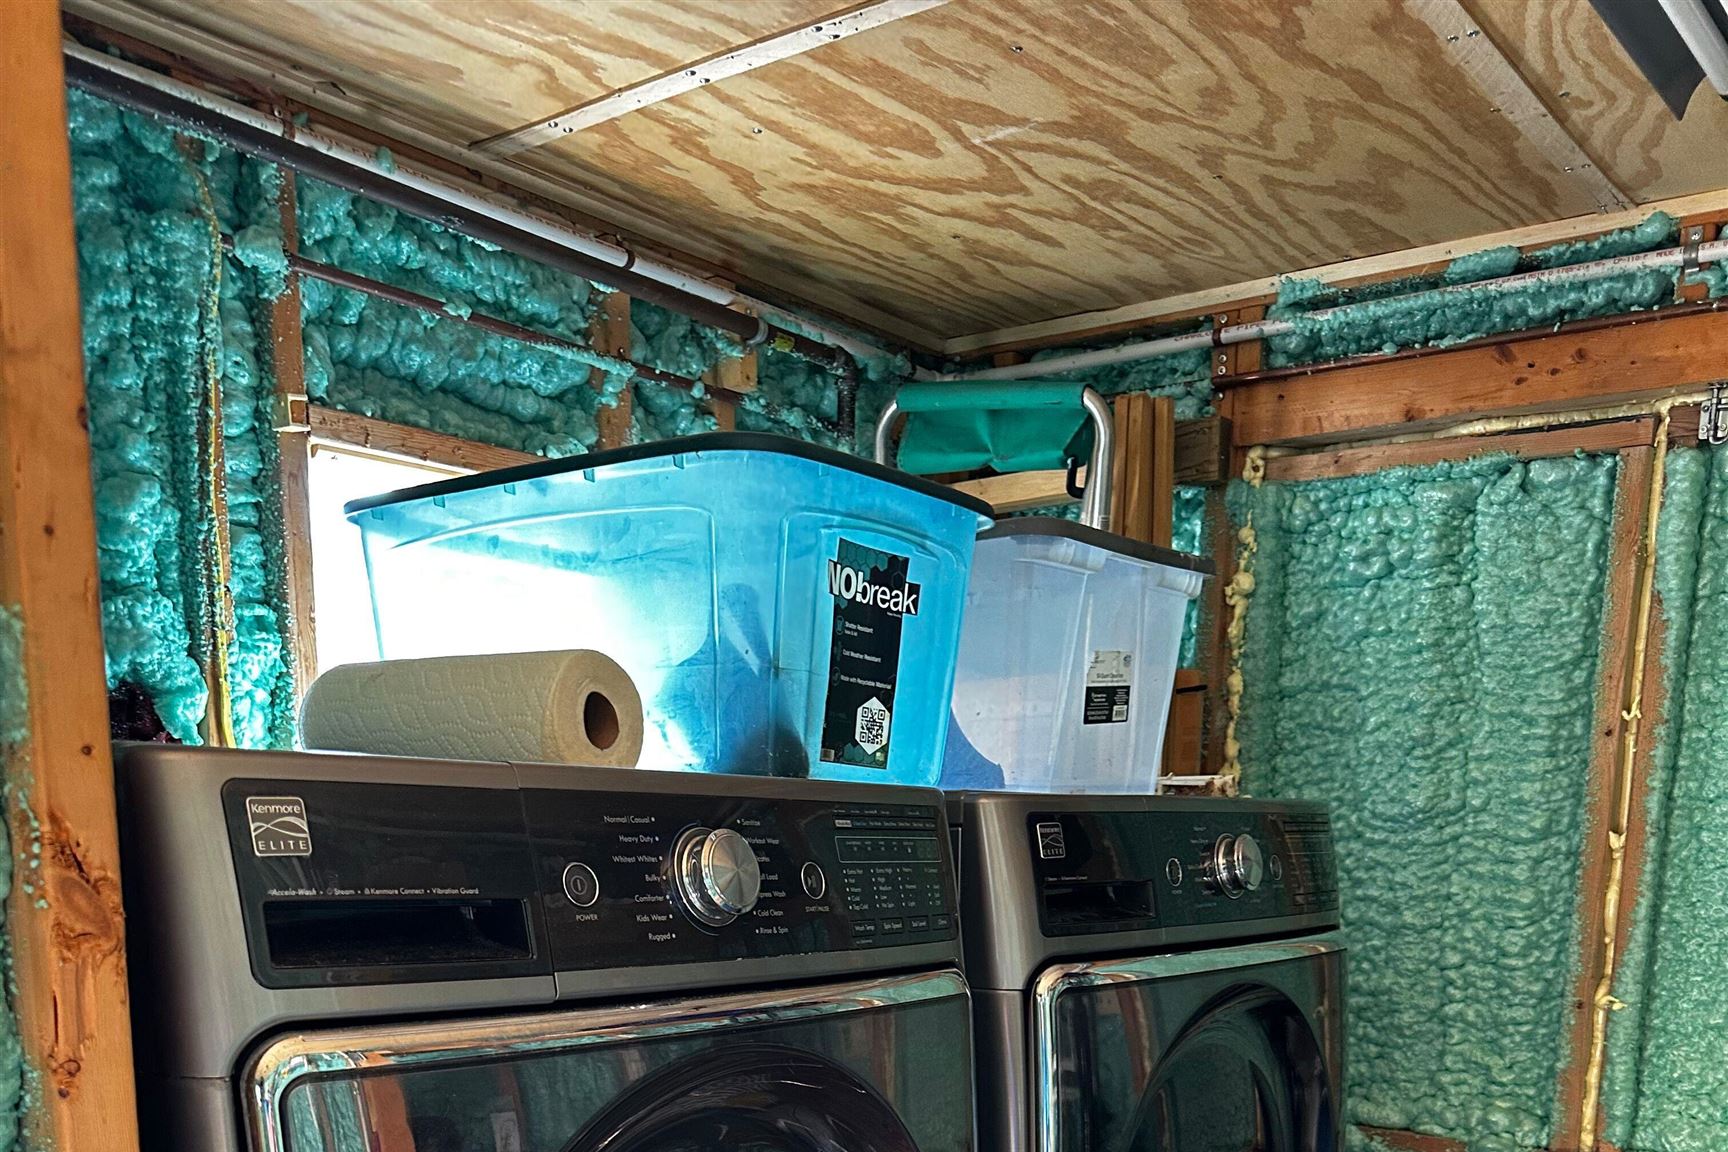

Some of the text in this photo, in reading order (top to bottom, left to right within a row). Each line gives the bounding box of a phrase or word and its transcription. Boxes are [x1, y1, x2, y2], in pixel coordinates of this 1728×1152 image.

[250, 803, 301, 814] Kenmore
[619, 834, 654, 844] Heavy Duty
[258, 840, 308, 851] ELITE
[612, 854, 659, 863] Whitest Whites
[645, 874, 661, 882] Bulky
[334, 887, 355, 895] Steam
[371, 887, 398, 895] Kenmore
[400, 887, 424, 895] Connect
[432, 887, 458, 895] Vibration
[634, 894, 665, 902] Comforter
[575, 913, 599, 921] POWER
[636, 913, 668, 922] Kids Wear
[758, 909, 784, 917] Cold Clean
[759, 926, 773, 935] Rinse
[778, 926, 789, 935] Spin
[648, 932, 671, 942] Rugged
